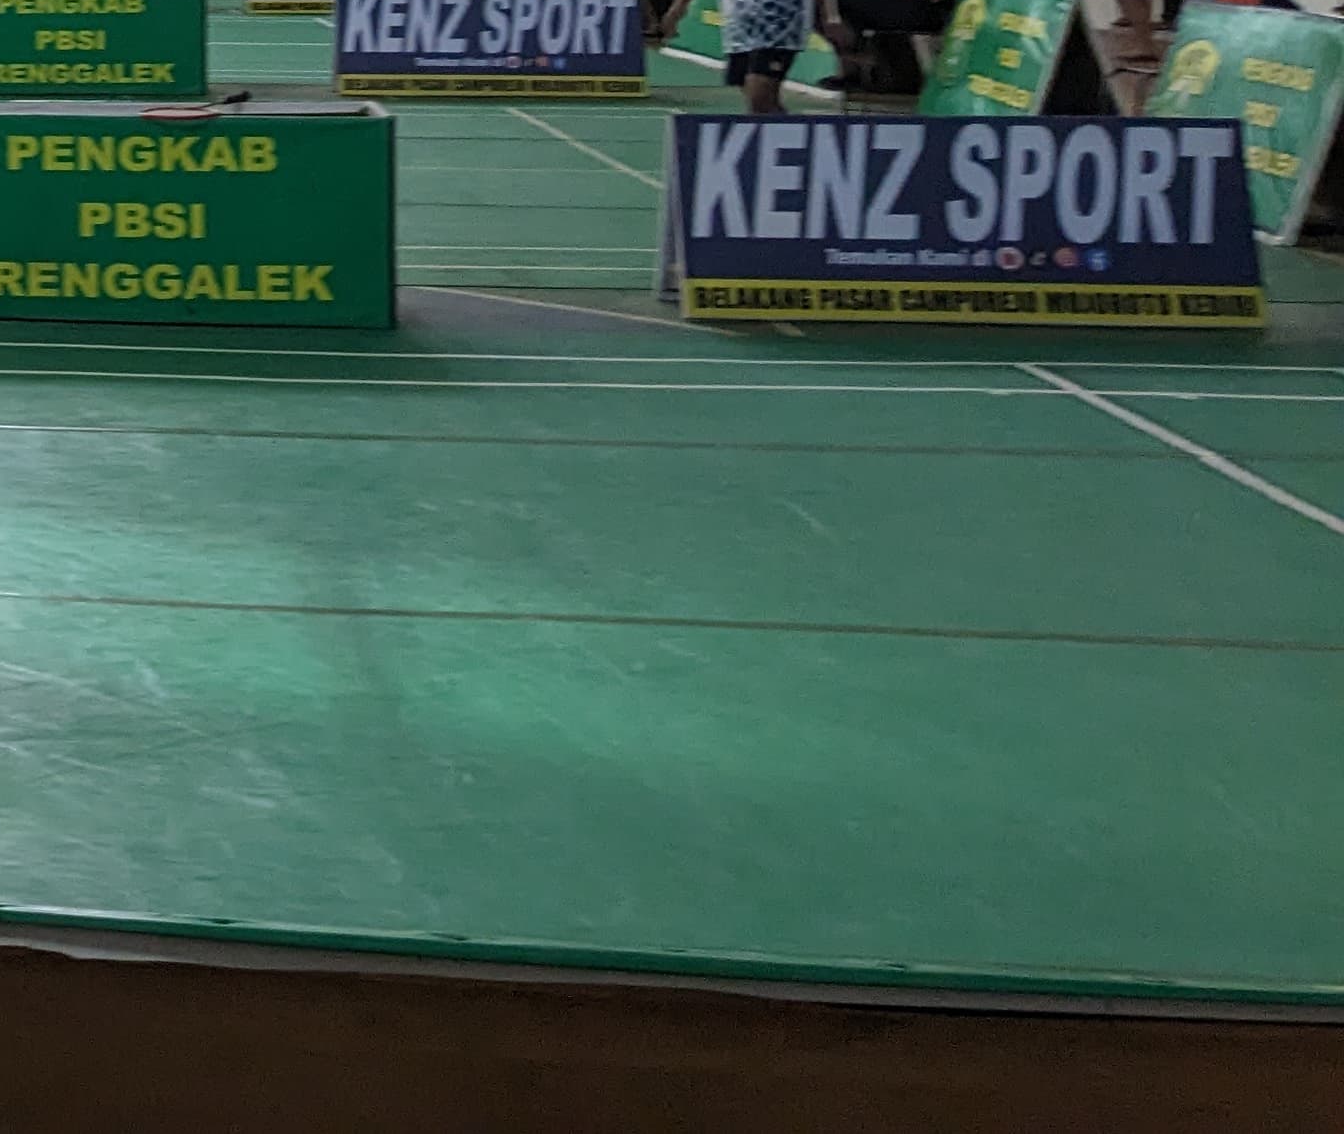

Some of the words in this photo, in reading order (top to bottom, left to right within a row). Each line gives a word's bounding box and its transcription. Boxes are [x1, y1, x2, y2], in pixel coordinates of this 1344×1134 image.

[34, 30, 106, 50] PBSI
[6, 135, 279, 173] PENGKAB
[691, 122, 926, 240] KENZ
[943, 123, 1234, 245] SPORT
[78, 201, 207, 240] PBSI
